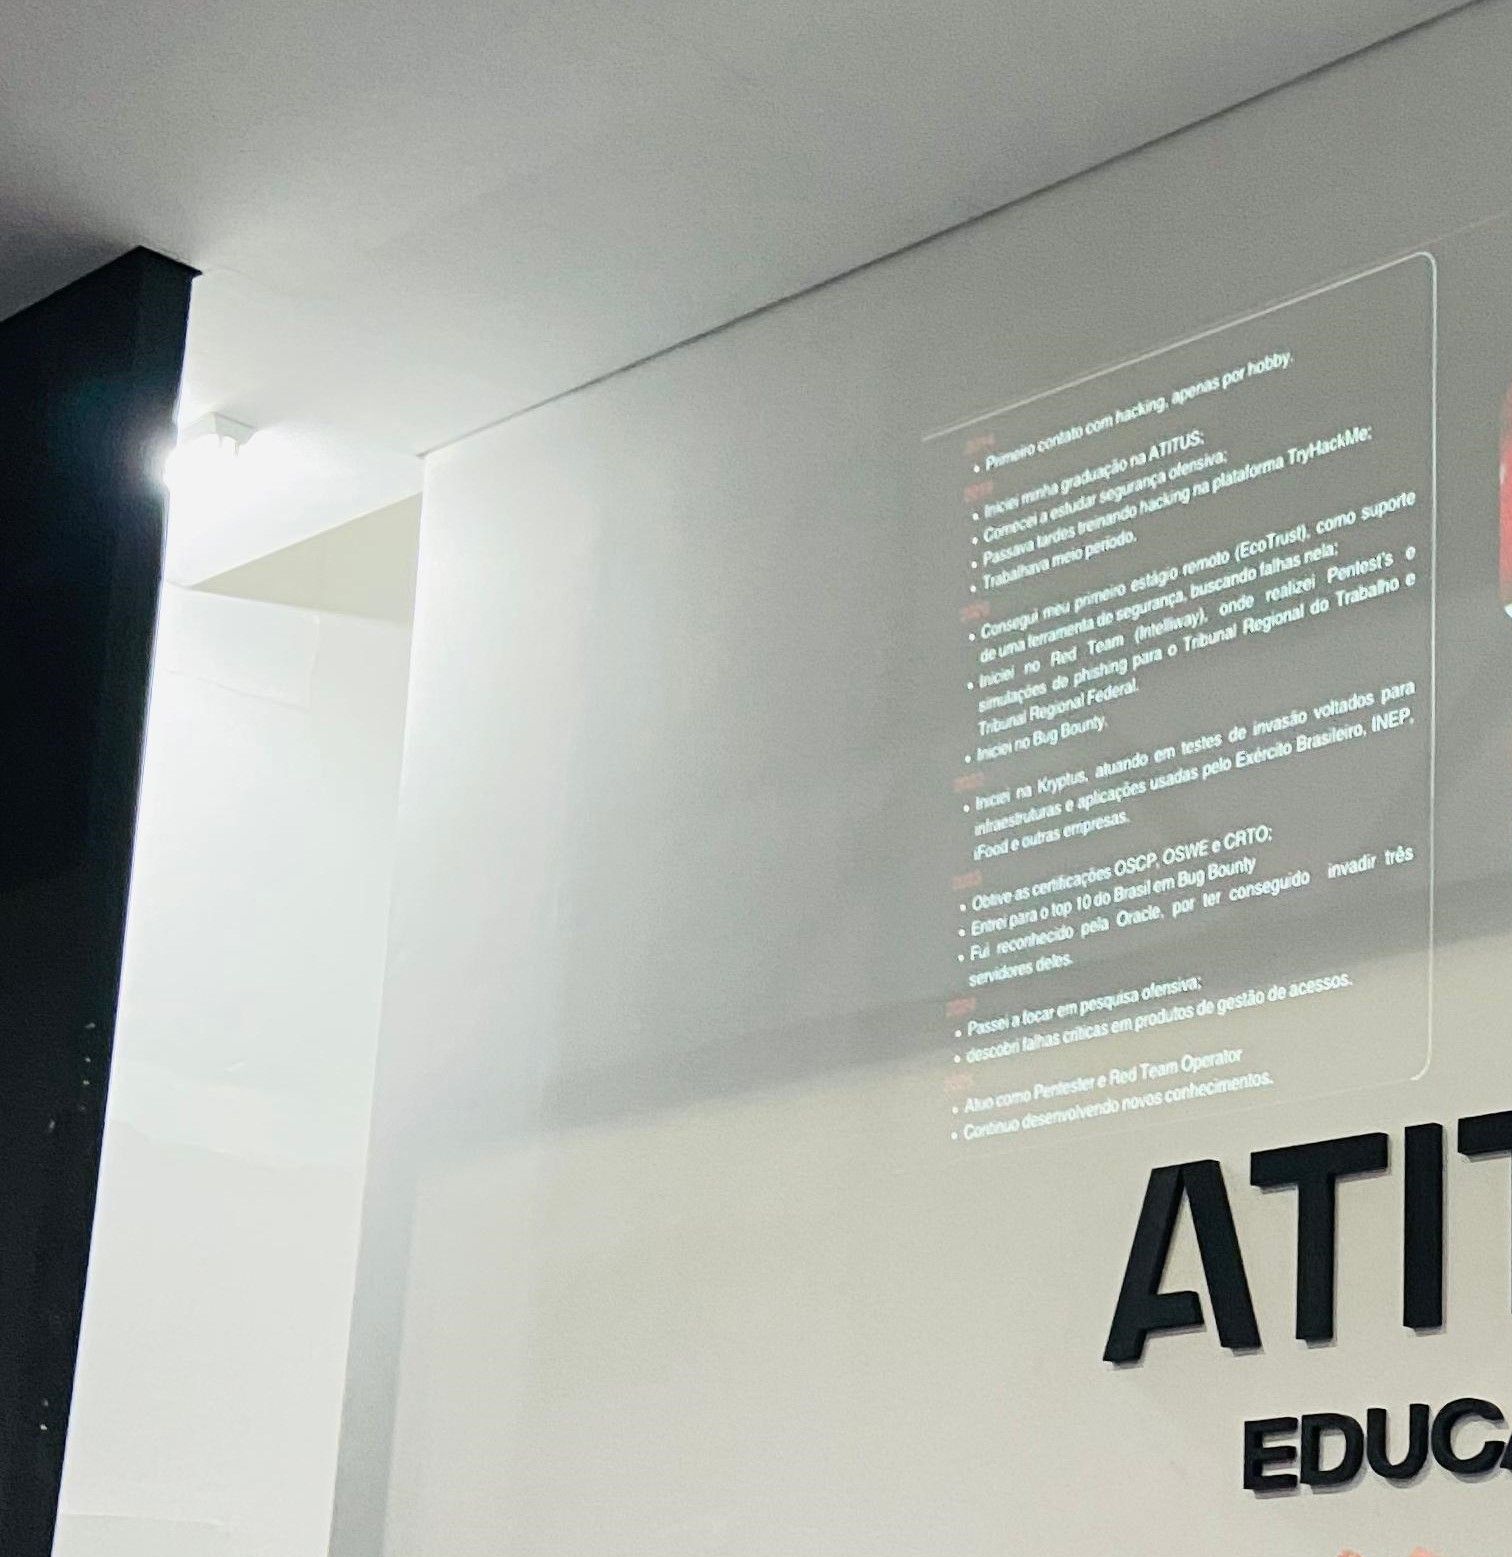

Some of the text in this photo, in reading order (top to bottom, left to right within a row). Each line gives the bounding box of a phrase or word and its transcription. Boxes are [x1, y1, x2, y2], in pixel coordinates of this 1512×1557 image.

[985, 443, 1036, 471] Primeiro
[1036, 425, 1084, 453] contato
[1084, 415, 1114, 436] com
[1171, 376, 1221, 405] apenas
[1221, 367, 1246, 390] por
[982, 539, 1035, 567] Passava
[1036, 525, 1076, 549] tardes
[1077, 504, 1138, 536] treinando
[1139, 487, 1191, 515] hacking
[1192, 480, 1210, 497] na
[1211, 455, 1285, 494] plataforma
[1020, 482, 1059, 505] minha
[1060, 458, 1128, 496] graduação
[1129, 452, 1147, 468] na
[1039, 511, 1048, 524] a
[1049, 493, 1097, 521] estudar
[1099, 470, 1167, 504] segurança
[980, 608, 1039, 640] Consegui
[1042, 601, 1071, 620] meu
[1074, 583, 1127, 614] primeiro
[1130, 566, 1179, 593] estágio
[1182, 550, 1230, 576] remoto
[1315, 510, 1357, 535] como
[1361, 491, 1416, 521] suporte
[982, 558, 1050, 590] Trabalhava
[1051, 548, 1083, 568] meio
[979, 647, 997, 664] de
[998, 639, 1026, 658] uma
[1027, 617, 1095, 649] ferramenta
[1096, 611, 1114, 628] de
[1190, 566, 1257, 599] buscando
[1259, 554, 1301, 577] falhas
[1023, 659, 1041, 675] no
[1050, 645, 1077, 667] Red
[1086, 634, 1125, 655] Team
[1218, 594, 1255, 617] onde
[1265, 573, 1316, 603] realizei
[1405, 545, 1416, 561] e
[1051, 674, 1069, 691] de
[1073, 658, 1128, 688] phishing
[1132, 648, 1163, 671] para
[1167, 643, 1178, 657] o
[1182, 622, 1237, 652] Tribunal
[1242, 602, 1305, 635] Regional
[1309, 598, 1329, 615] do
[1334, 577, 1400, 607] Trabalho
[1404, 572, 1416, 587] e
[978, 709, 1027, 736] Tribunal
[1029, 692, 1085, 721] Regional
[1014, 736, 1031, 752] no
[1032, 728, 1059, 747] Bug
[1015, 785, 1033, 800] na
[1094, 752, 1149, 779] atuando
[1153, 746, 1176, 763] em
[1180, 733, 1221, 756] testes
[1227, 725, 1247, 743] de
[1252, 709, 1308, 737] invasão
[1313, 692, 1375, 720] voltados
[1380, 681, 1415, 706] para
[1064, 799, 1074, 813] e
[1077, 780, 1147, 811] aplicações
[1149, 767, 1199, 791] usadas
[1201, 756, 1232, 781] pelo
[1235, 741, 1293, 768] Exército
[1010, 838, 1020, 852] e
[1021, 828, 1061, 849] outras
[1014, 886, 1031, 901] as
[1031, 866, 1112, 897] certificações
[1162, 838, 1209, 865] OSWE
[1211, 839, 1221, 854] e
[970, 856, 1257, 937] Entrei para o top 10 do Brasil em Bug Bounty
[970, 942, 991, 961] Fui
[996, 924, 1075, 955] reconhecido
[1080, 916, 1110, 939] pela
[1171, 897, 1196, 919] por
[1202, 891, 1222, 908] ter
[1228, 869, 1311, 901] conseguido
[1327, 853, 1377, 879] invadir
[1384, 845, 1414, 866] três
[968, 961, 1034, 988] servidores
[967, 1017, 1010, 1037] Passei
[1011, 1014, 1021, 1028] a
[1022, 1007, 1055, 1025] focar
[1056, 1002, 1078, 1018] em
[1079, 989, 1140, 1017] pesquisa
[1022, 1032, 1061, 1052] falhas
[1110, 1017, 1133, 1034] em
[1134, 1005, 1195, 1033] produtos
[1196, 998, 1215, 1017] de
[1216, 989, 1265, 1016] gestão
[1266, 984, 1287, 1002] de
[995, 1089, 1032, 1108] como
[1033, 1077, 1096, 1100] Pentester
[1096, 1074, 1107, 1089] e
[1109, 1065, 1138, 1086] Red
[1139, 1061, 1179, 1080] Team
[1180, 1048, 1243, 1074] Operator
[1021, 1097, 1120, 1130] desenvolvendo
[1121, 1091, 1163, 1112] novos
